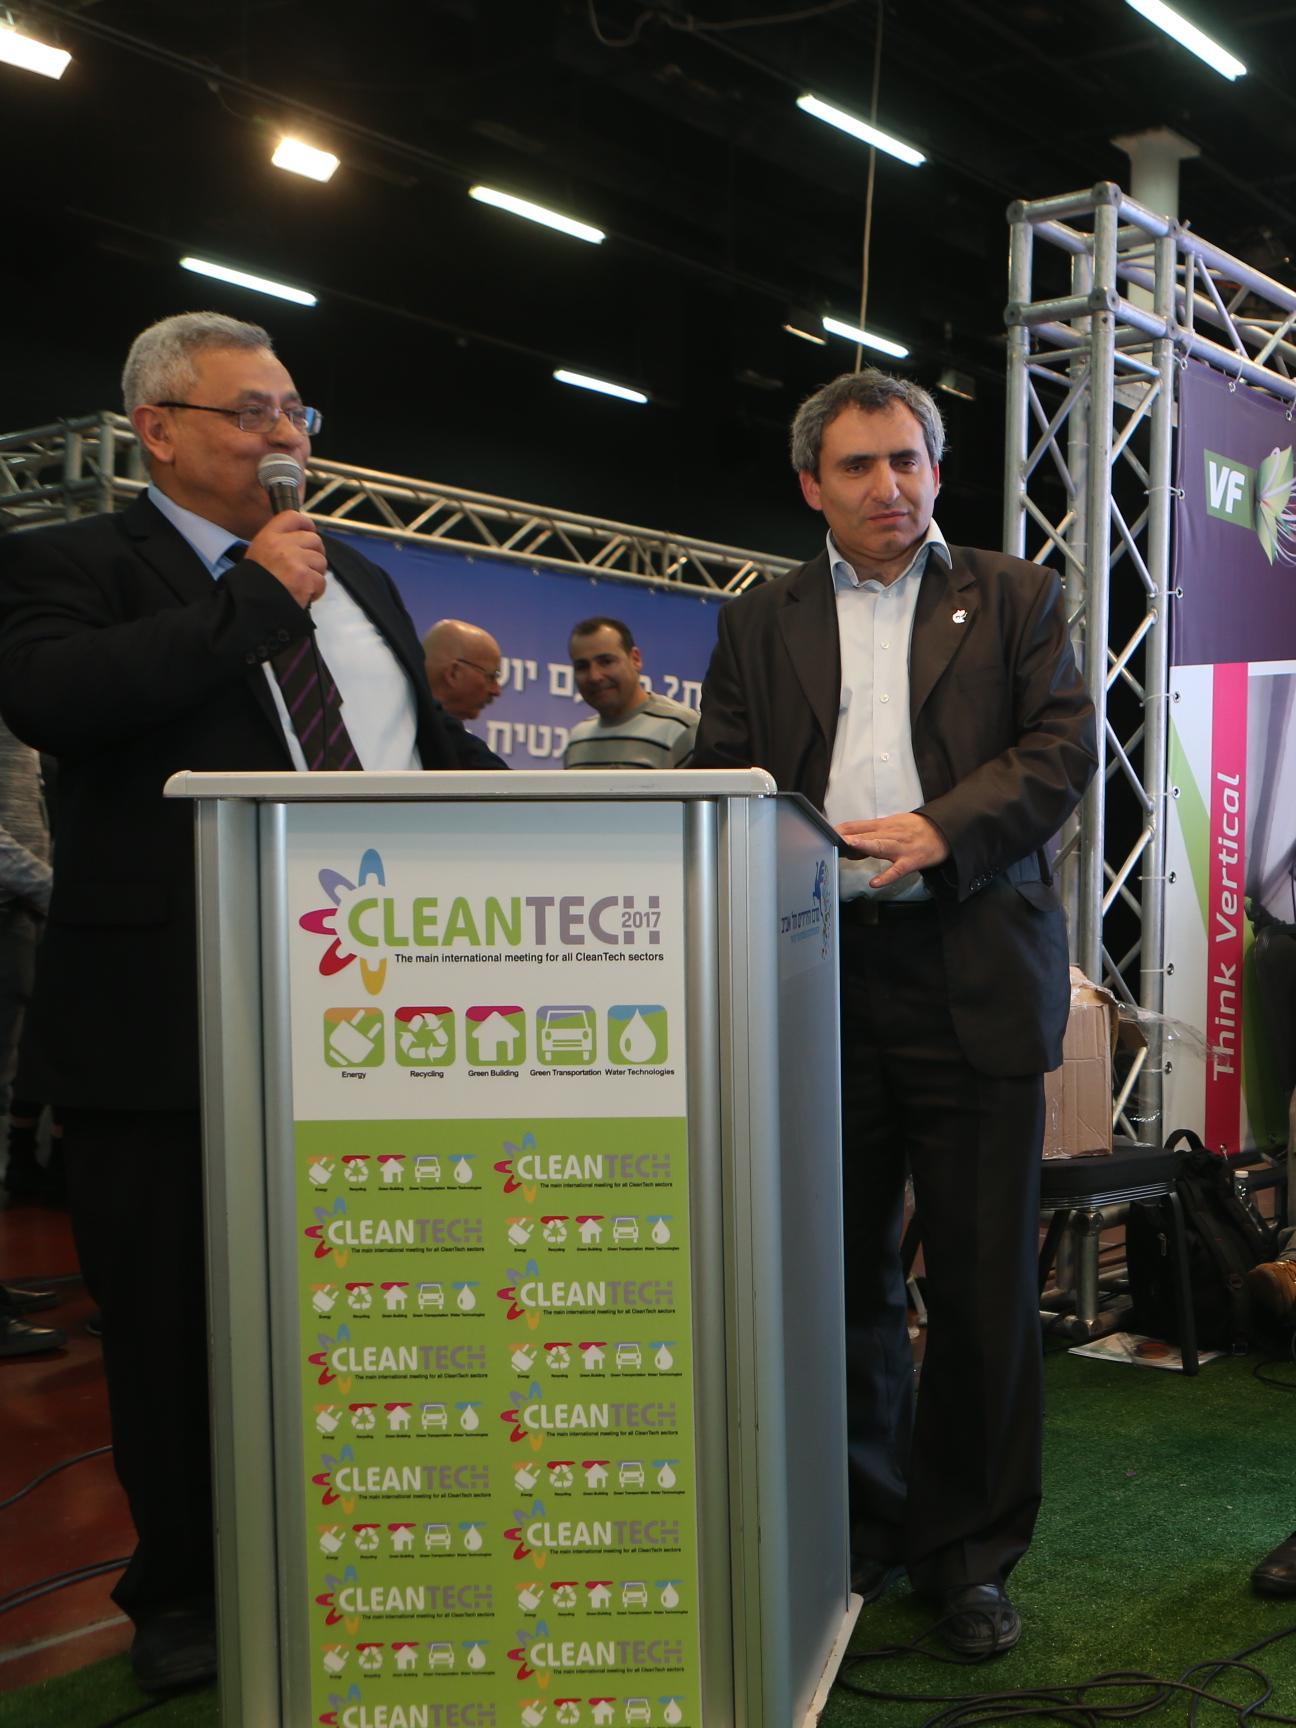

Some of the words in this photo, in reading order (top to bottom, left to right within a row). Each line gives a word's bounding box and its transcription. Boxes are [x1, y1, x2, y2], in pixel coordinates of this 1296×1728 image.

[1208, 460, 1246, 514] VF
[1215, 773, 1241, 943] Vertical
[347, 896, 661, 948] CLEANTECH
[621, 911, 661, 929] 2017
[394, 953, 413, 963] The
[416, 953, 439, 963] main
[442, 953, 502, 963] international
[505, 952, 543, 965] meeting
[546, 952, 559, 962] for
[562, 952, 573, 962] all
[576, 951, 625, 962] CleanTech
[628, 952, 664, 962] sectors
[1212, 962, 1239, 1082] Think
[341, 1070, 367, 1080] Energy
[410, 1069, 444, 1079] Recycling
[468, 1069, 488, 1077] Green
[491, 1068, 519, 1078] Building
[530, 1068, 550, 1077] Green
[552, 1068, 601, 1078] Transportation
[605, 1067, 626, 1077] Water
[627, 1067, 675, 1077] Technologies
[517, 1154, 672, 1180] CLEANTECH
[328, 1218, 483, 1245] CLEANTECH
[520, 1281, 674, 1307] CLEANTECH
[331, 1345, 487, 1372] CLEANTECH
[523, 1403, 677, 1429] CLEANTECH
[336, 1465, 490, 1492] CLEANTECH
[526, 1520, 680, 1546] CLEANTECH
[339, 1585, 493, 1612] CLEANTECH
[529, 1640, 683, 1667] CLEANTECH
